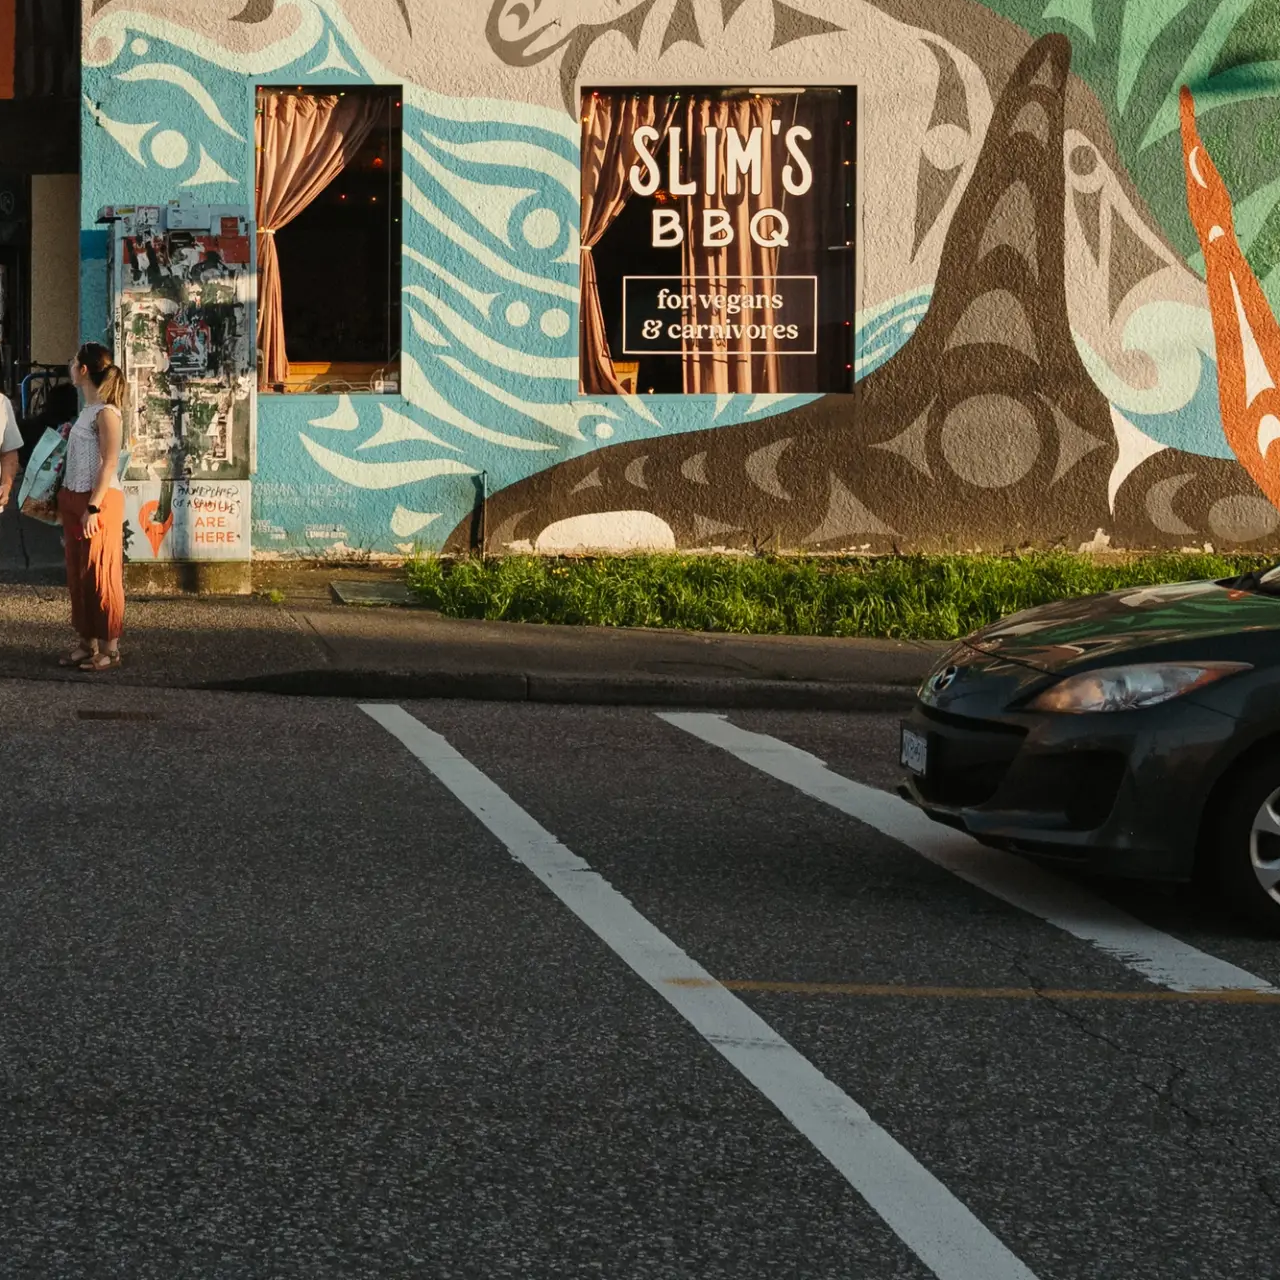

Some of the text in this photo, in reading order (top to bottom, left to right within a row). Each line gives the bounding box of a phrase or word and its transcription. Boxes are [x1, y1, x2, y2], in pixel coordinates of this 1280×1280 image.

[629, 119, 813, 197] SLIM'S
[651, 207, 790, 249] BBQ
[657, 288, 784, 314] for vegans
[642, 319, 799, 340] & carnivores
[195, 517, 226, 528] ARE
[195, 532, 235, 543] HERE
